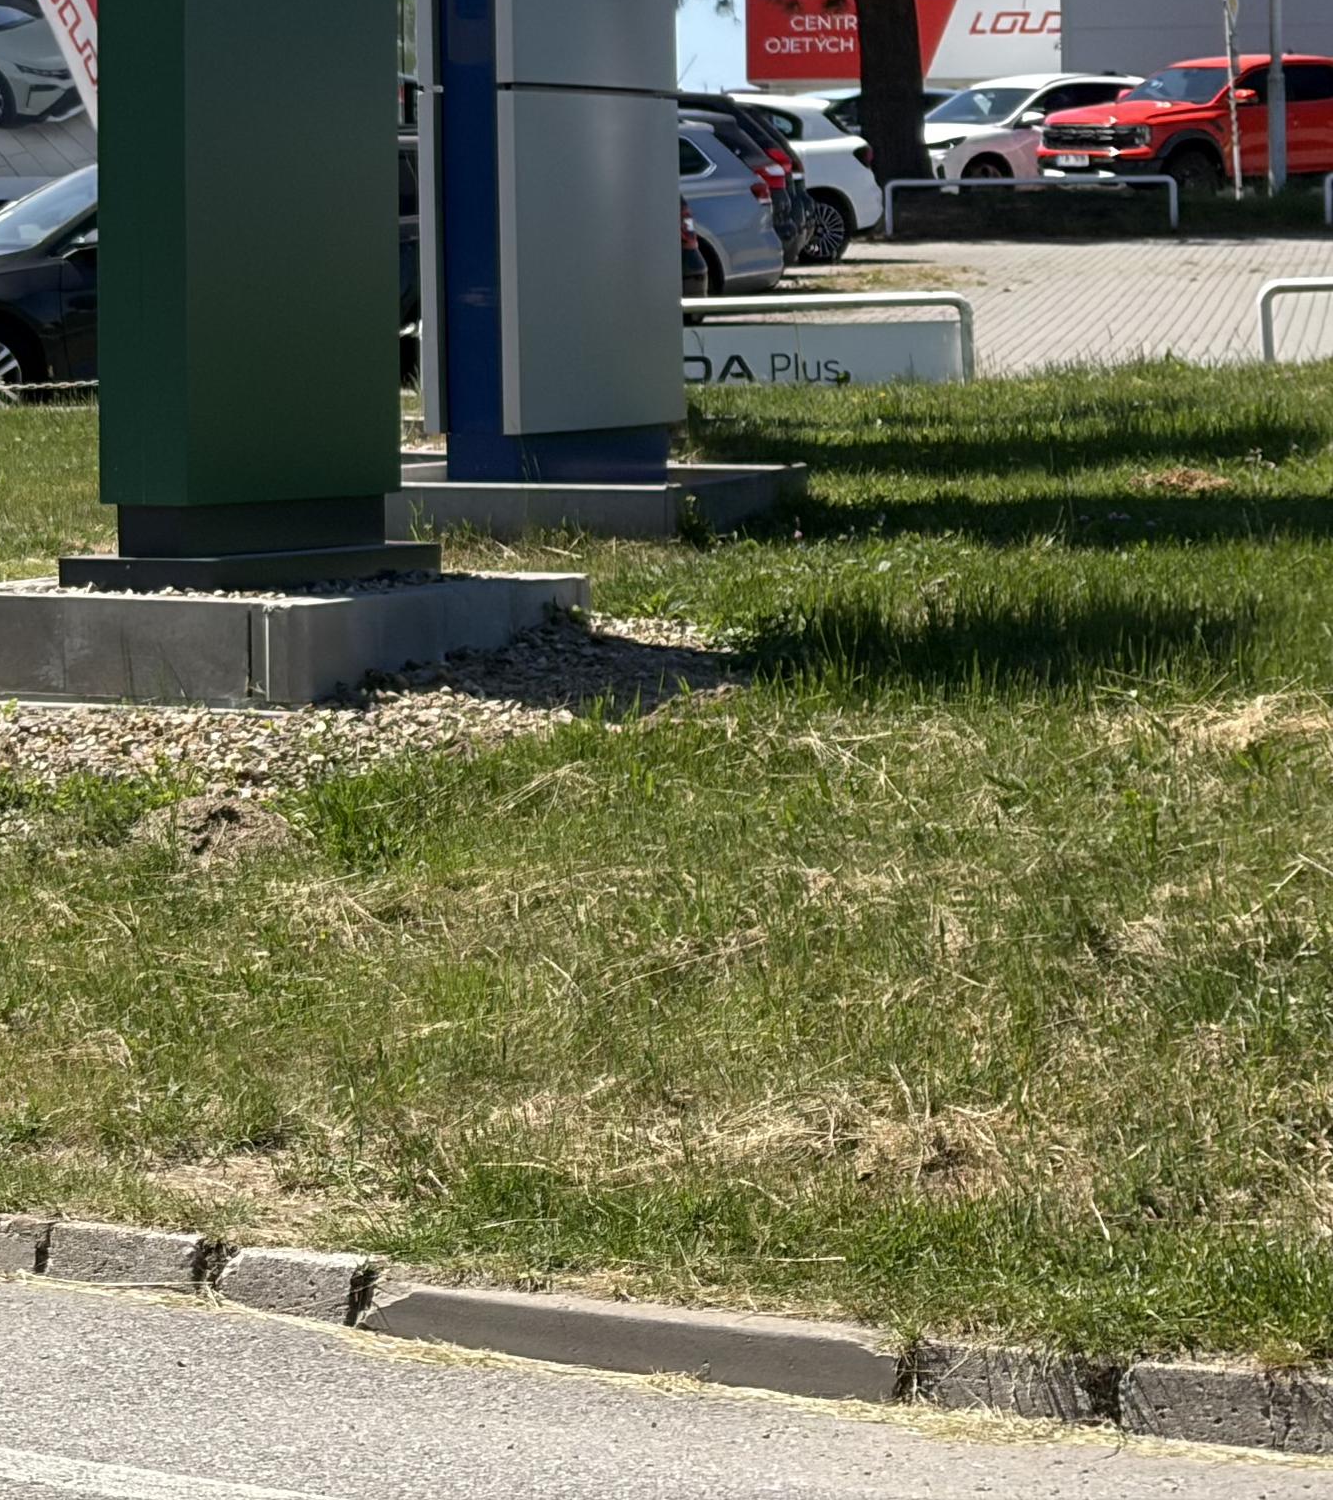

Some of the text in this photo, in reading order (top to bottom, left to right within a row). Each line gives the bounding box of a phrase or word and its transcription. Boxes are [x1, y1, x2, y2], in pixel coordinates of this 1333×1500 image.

[790, 12, 858, 32] CENTR
[765, 33, 855, 54] OJETÝCH
[770, 352, 841, 383] Plus
